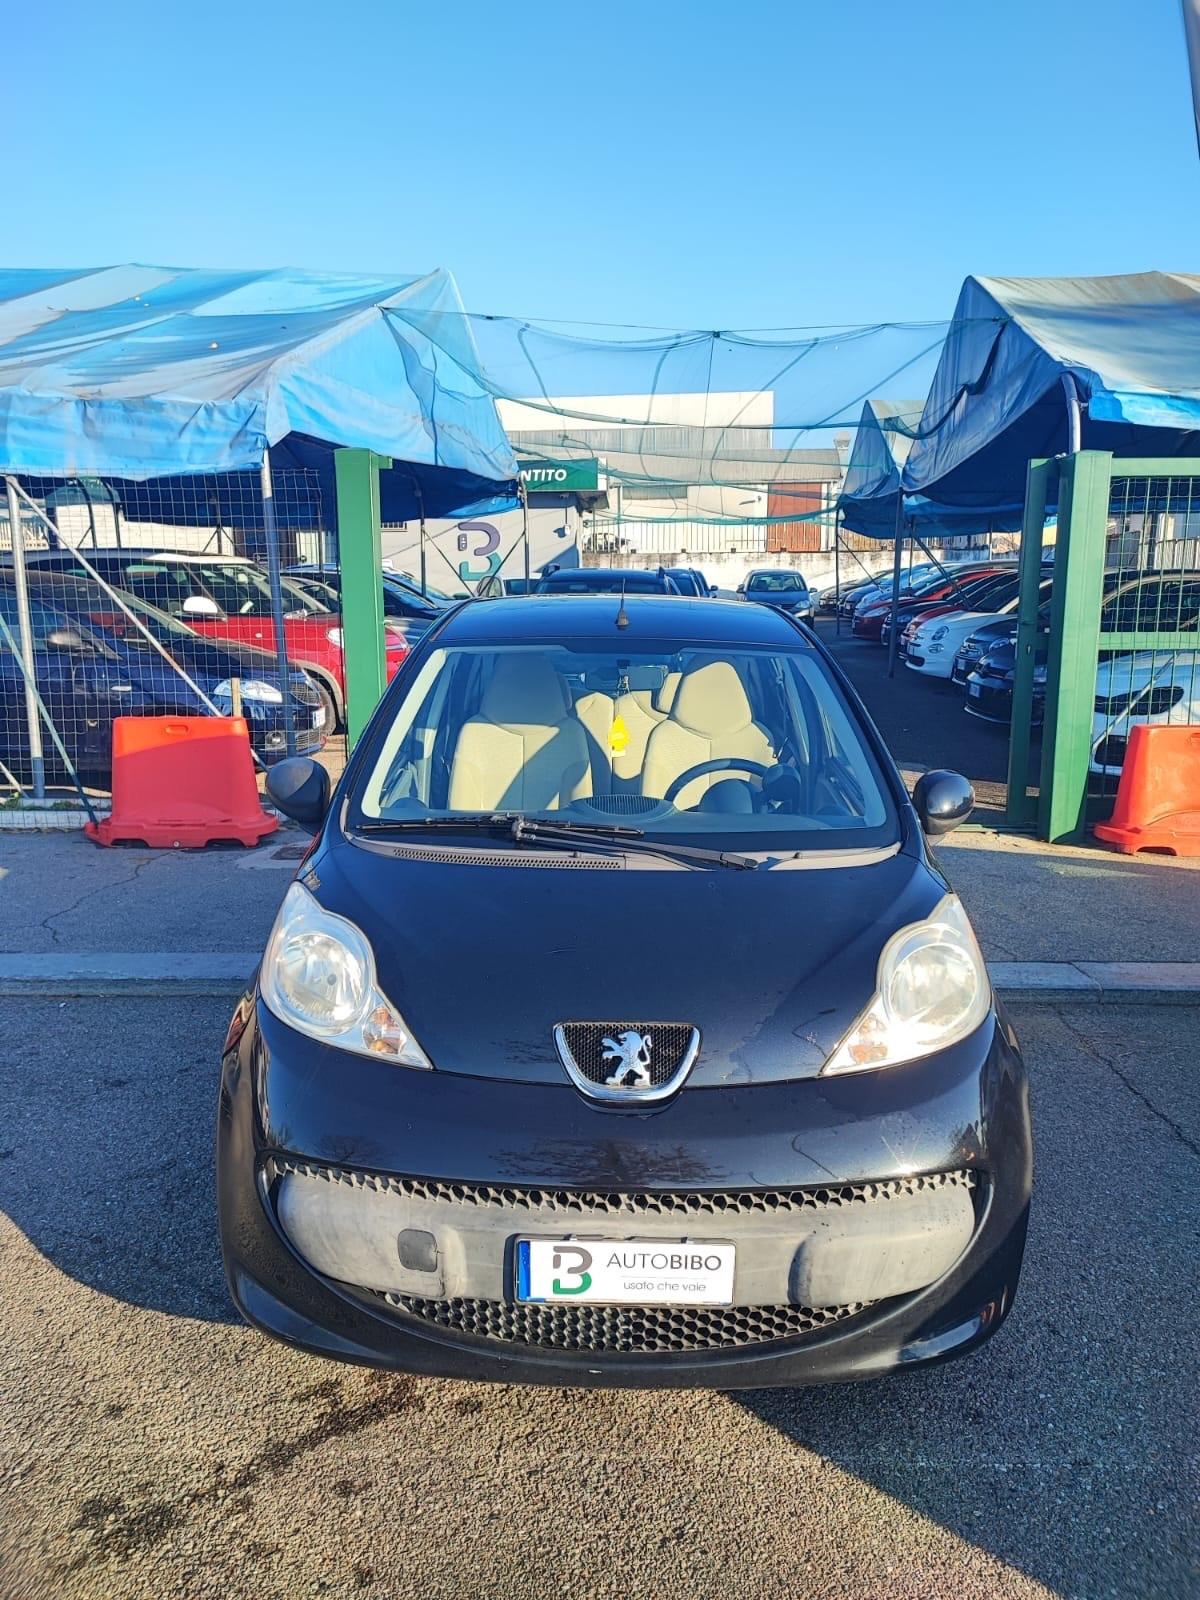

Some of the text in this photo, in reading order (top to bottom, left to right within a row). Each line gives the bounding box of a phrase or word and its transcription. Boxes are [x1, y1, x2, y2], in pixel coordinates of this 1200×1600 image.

[606, 1253, 721, 1270] AUTOBIBO
[624, 1281, 706, 1292] usato che vale
